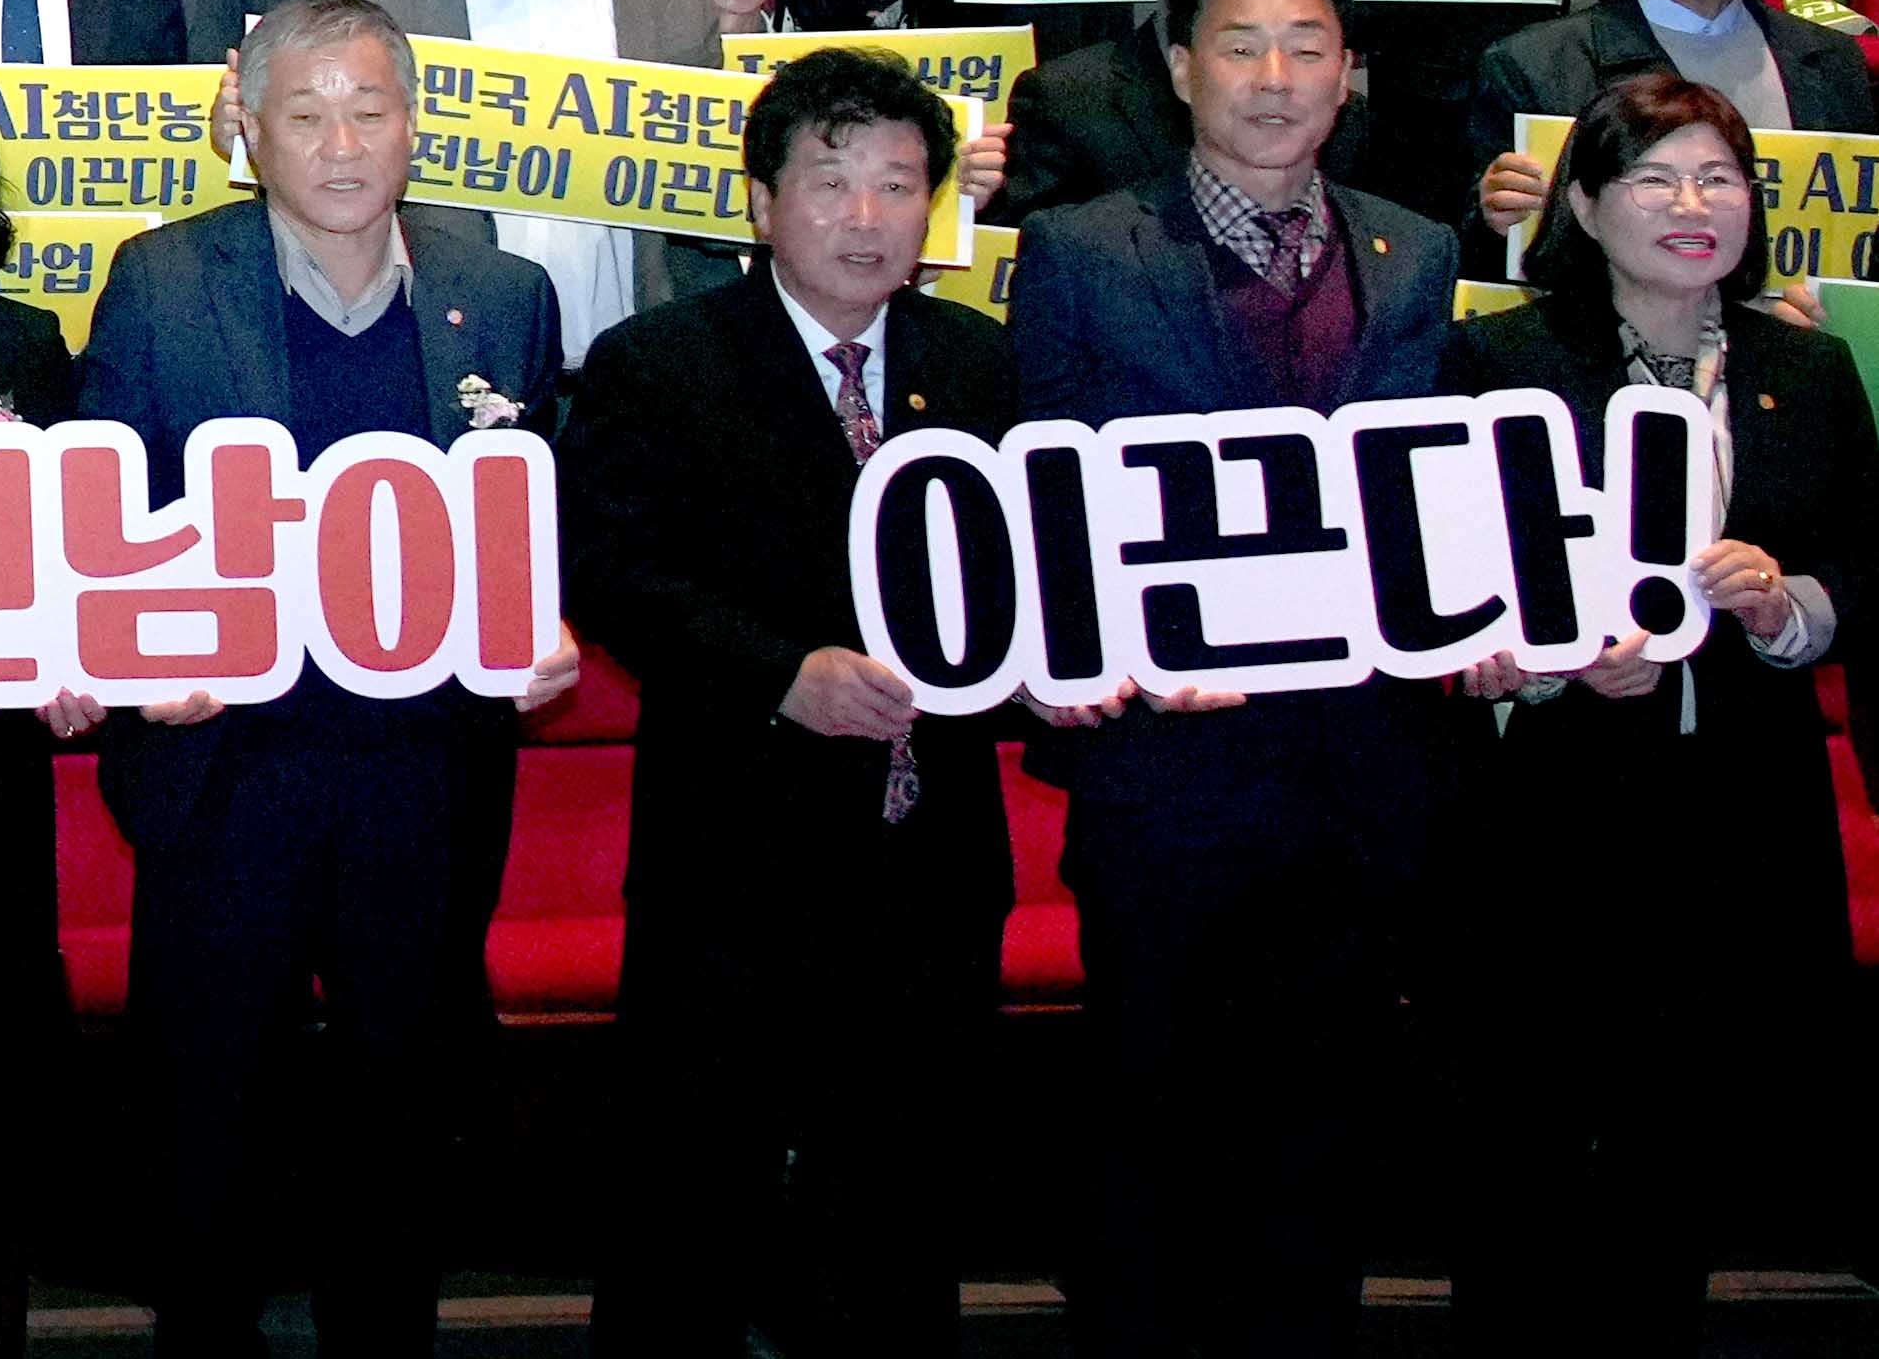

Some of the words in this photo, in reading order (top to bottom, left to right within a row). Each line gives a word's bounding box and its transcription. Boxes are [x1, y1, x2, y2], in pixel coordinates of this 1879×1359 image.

[26, 156, 197, 207] 이끈다!
[411, 134, 573, 201] 전남이
[874, 408, 1690, 689] 이끈다!
